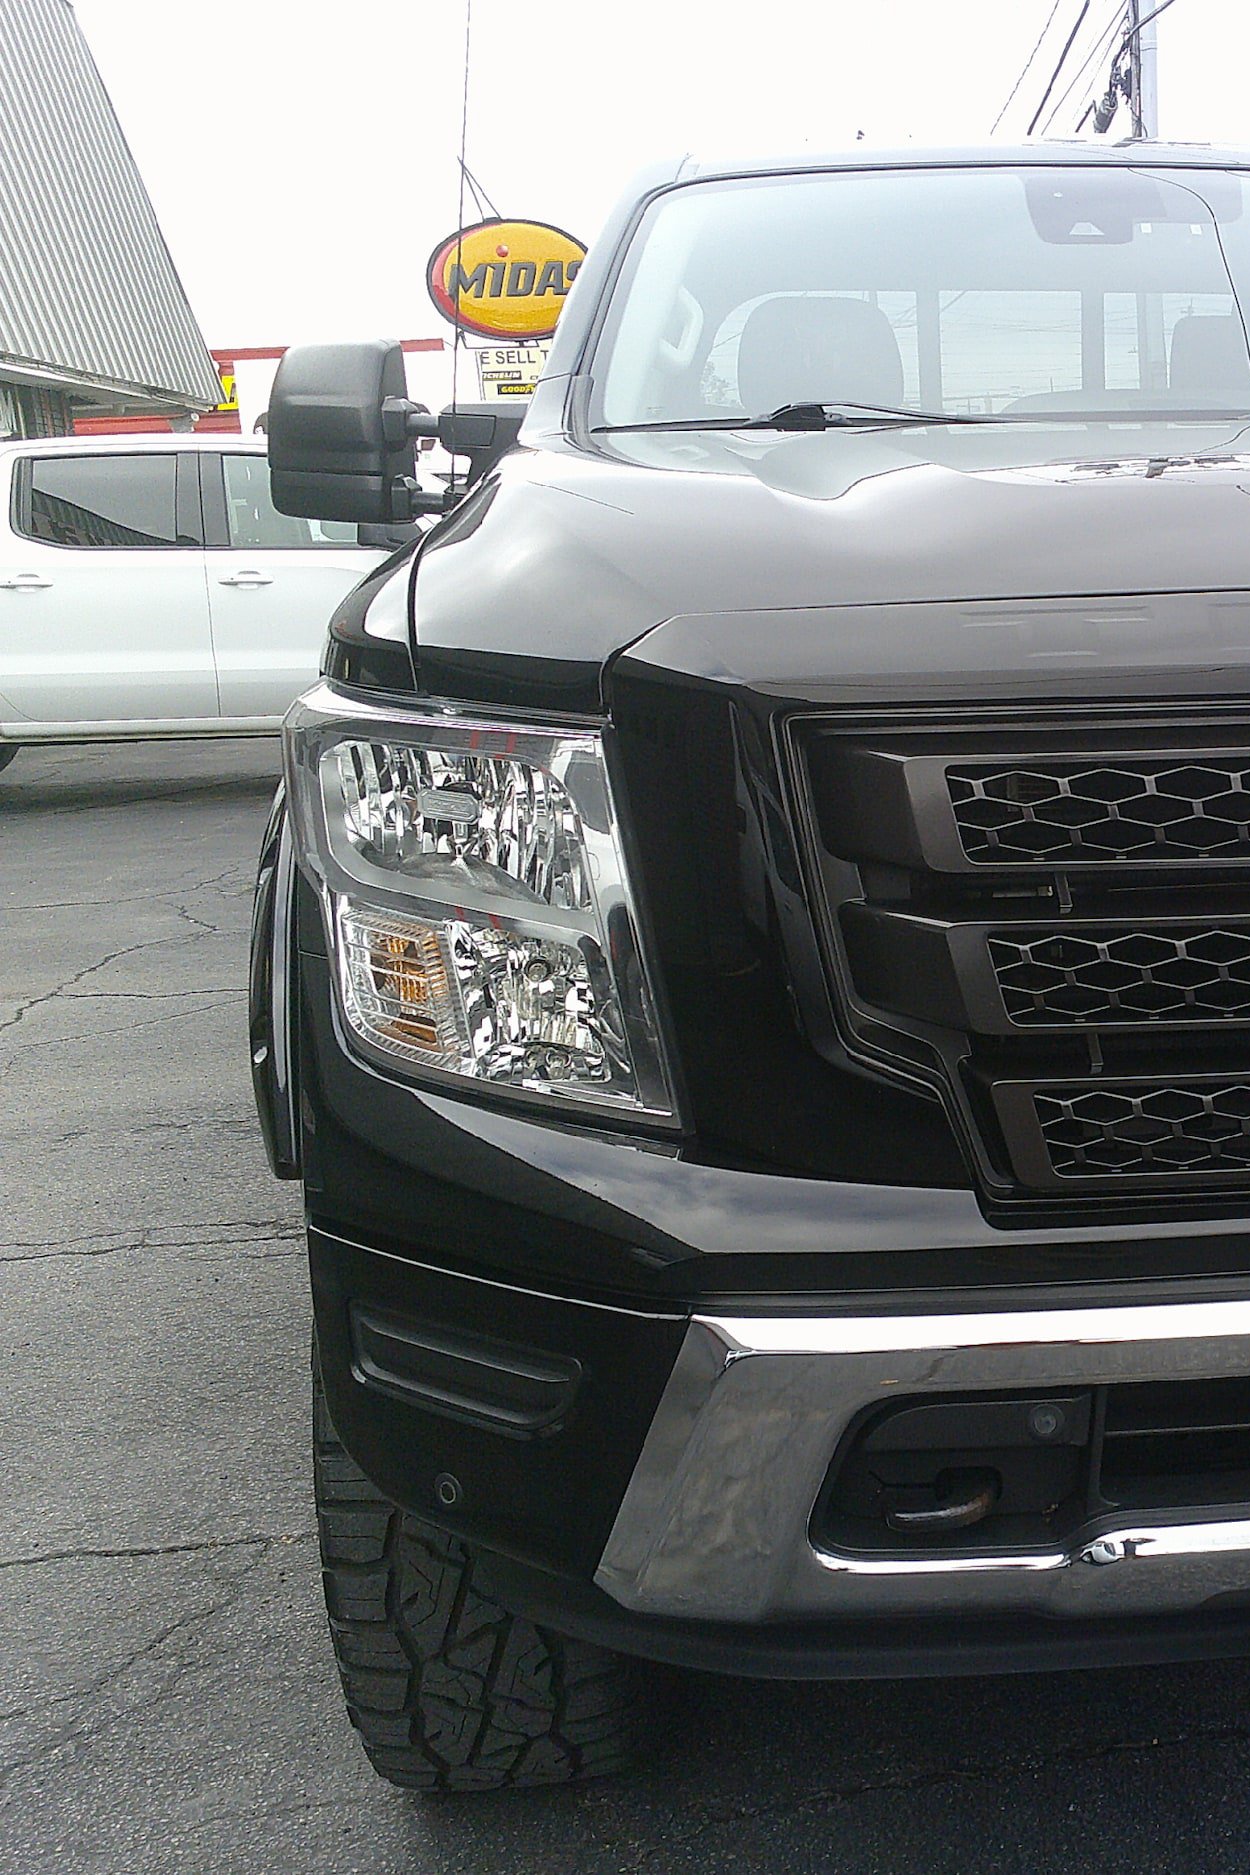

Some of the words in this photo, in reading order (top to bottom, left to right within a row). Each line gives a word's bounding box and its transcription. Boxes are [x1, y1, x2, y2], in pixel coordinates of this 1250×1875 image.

[495, 350, 537, 364] SELL
[482, 371, 521, 380] ICHELIN
[501, 384, 536, 394] GOODY
